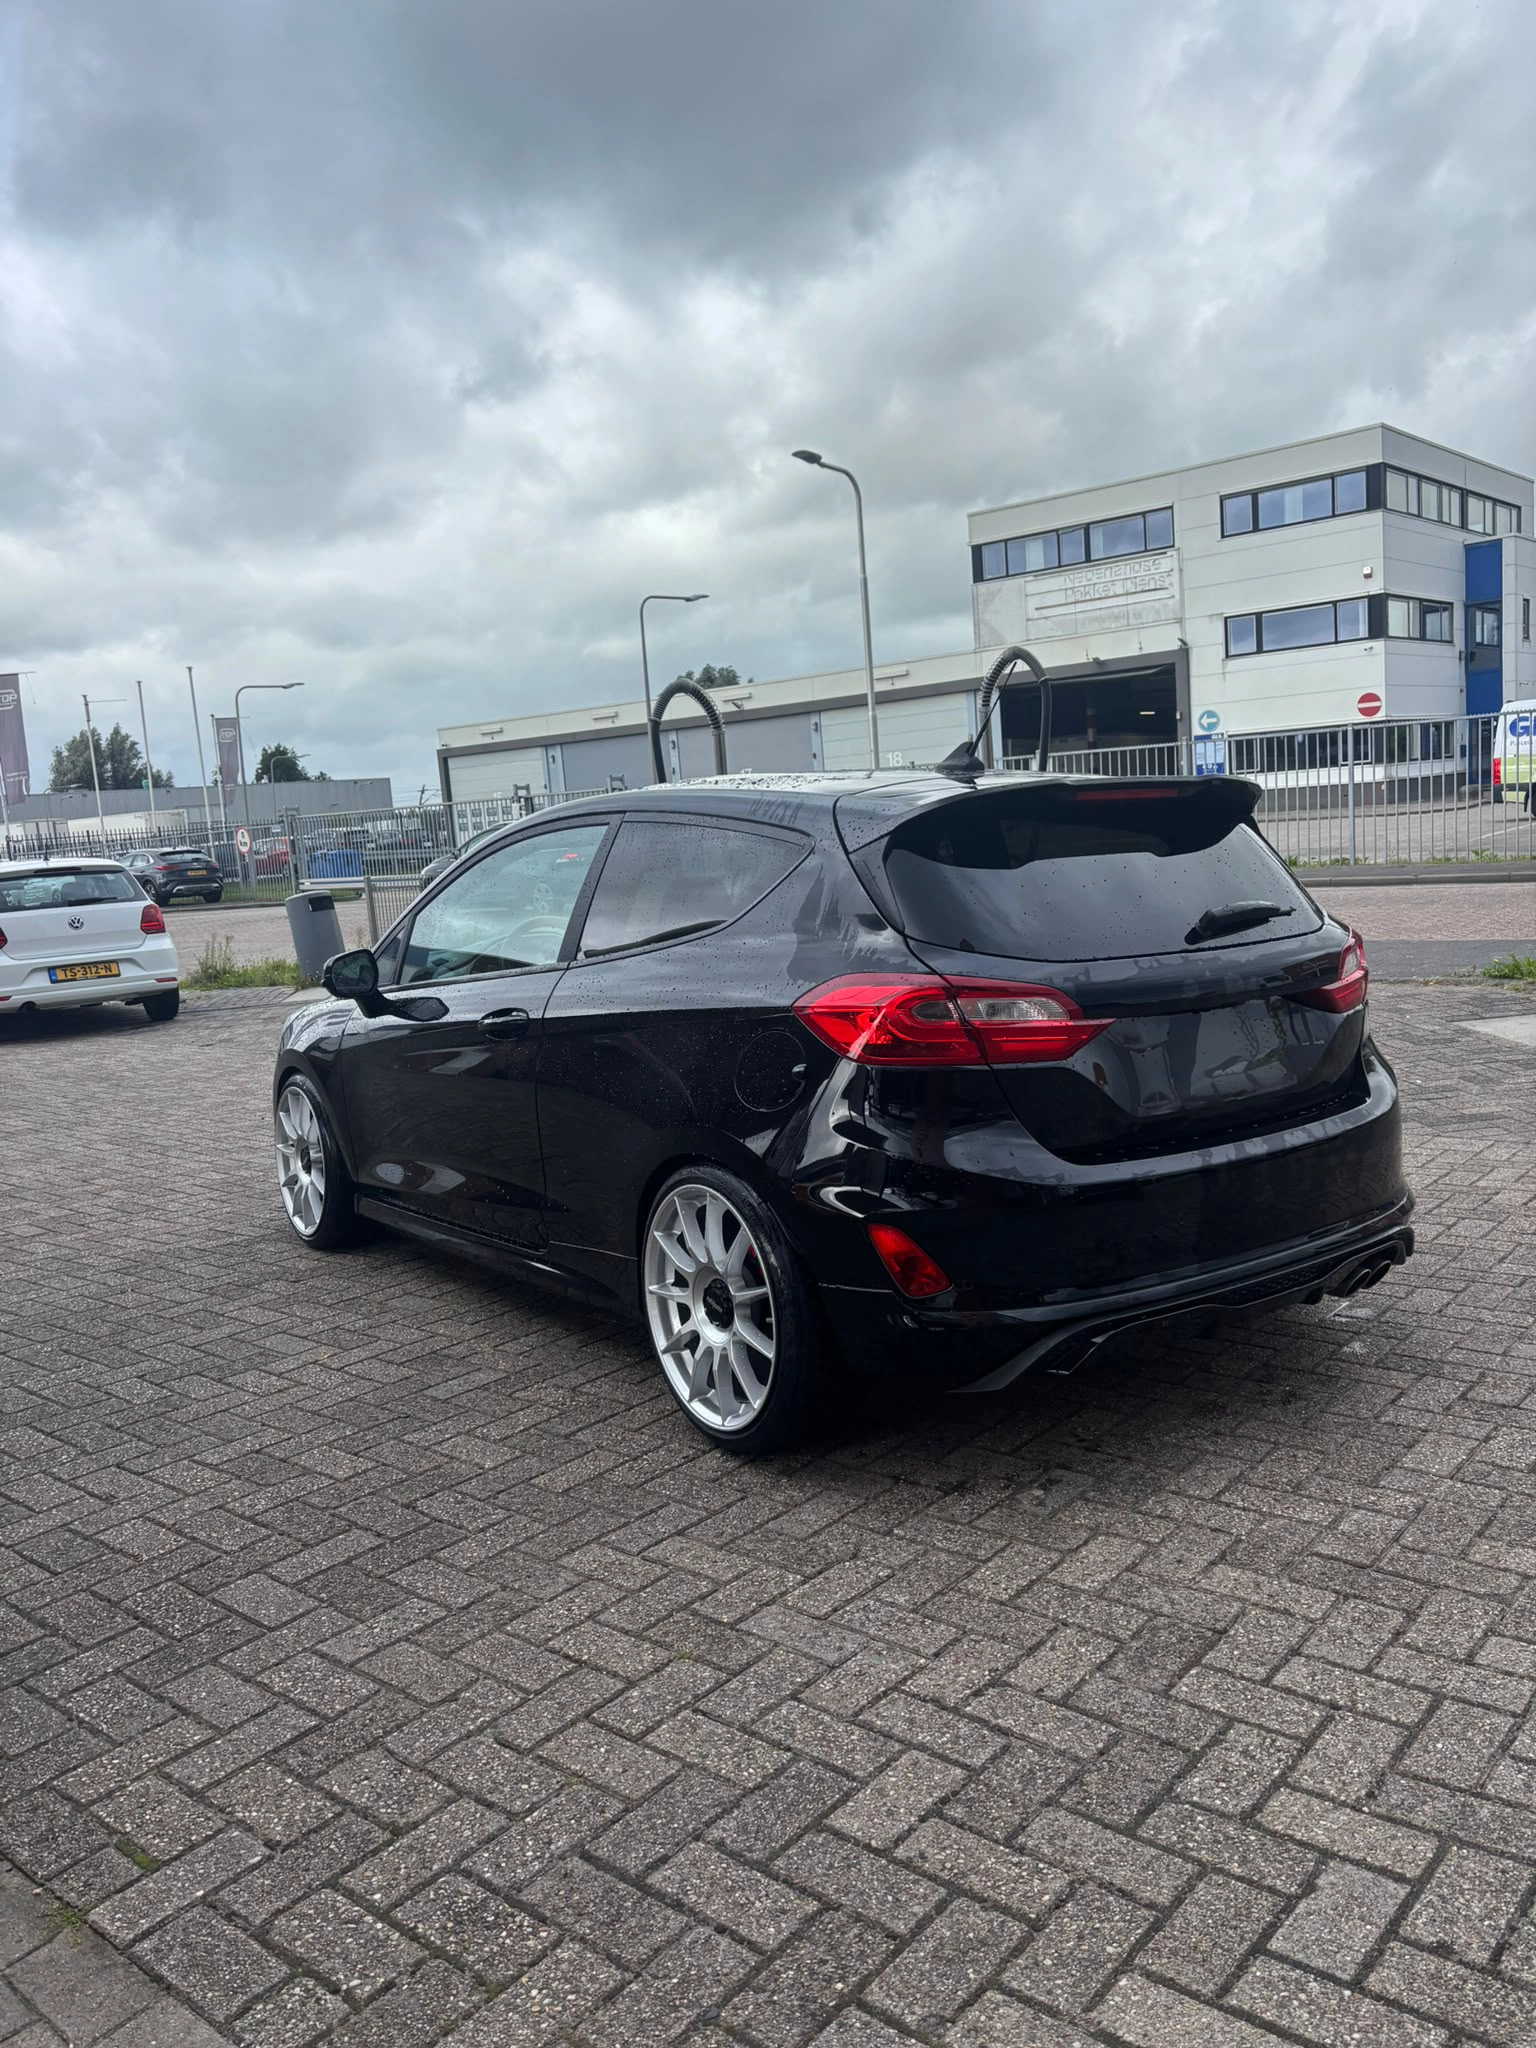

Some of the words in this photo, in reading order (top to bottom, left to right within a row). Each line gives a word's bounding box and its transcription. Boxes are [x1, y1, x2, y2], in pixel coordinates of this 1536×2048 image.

[1064, 582, 1118, 603] Pakket
[885, 751, 903, 767] 18
[61, 964, 113, 979] TS-312-N
